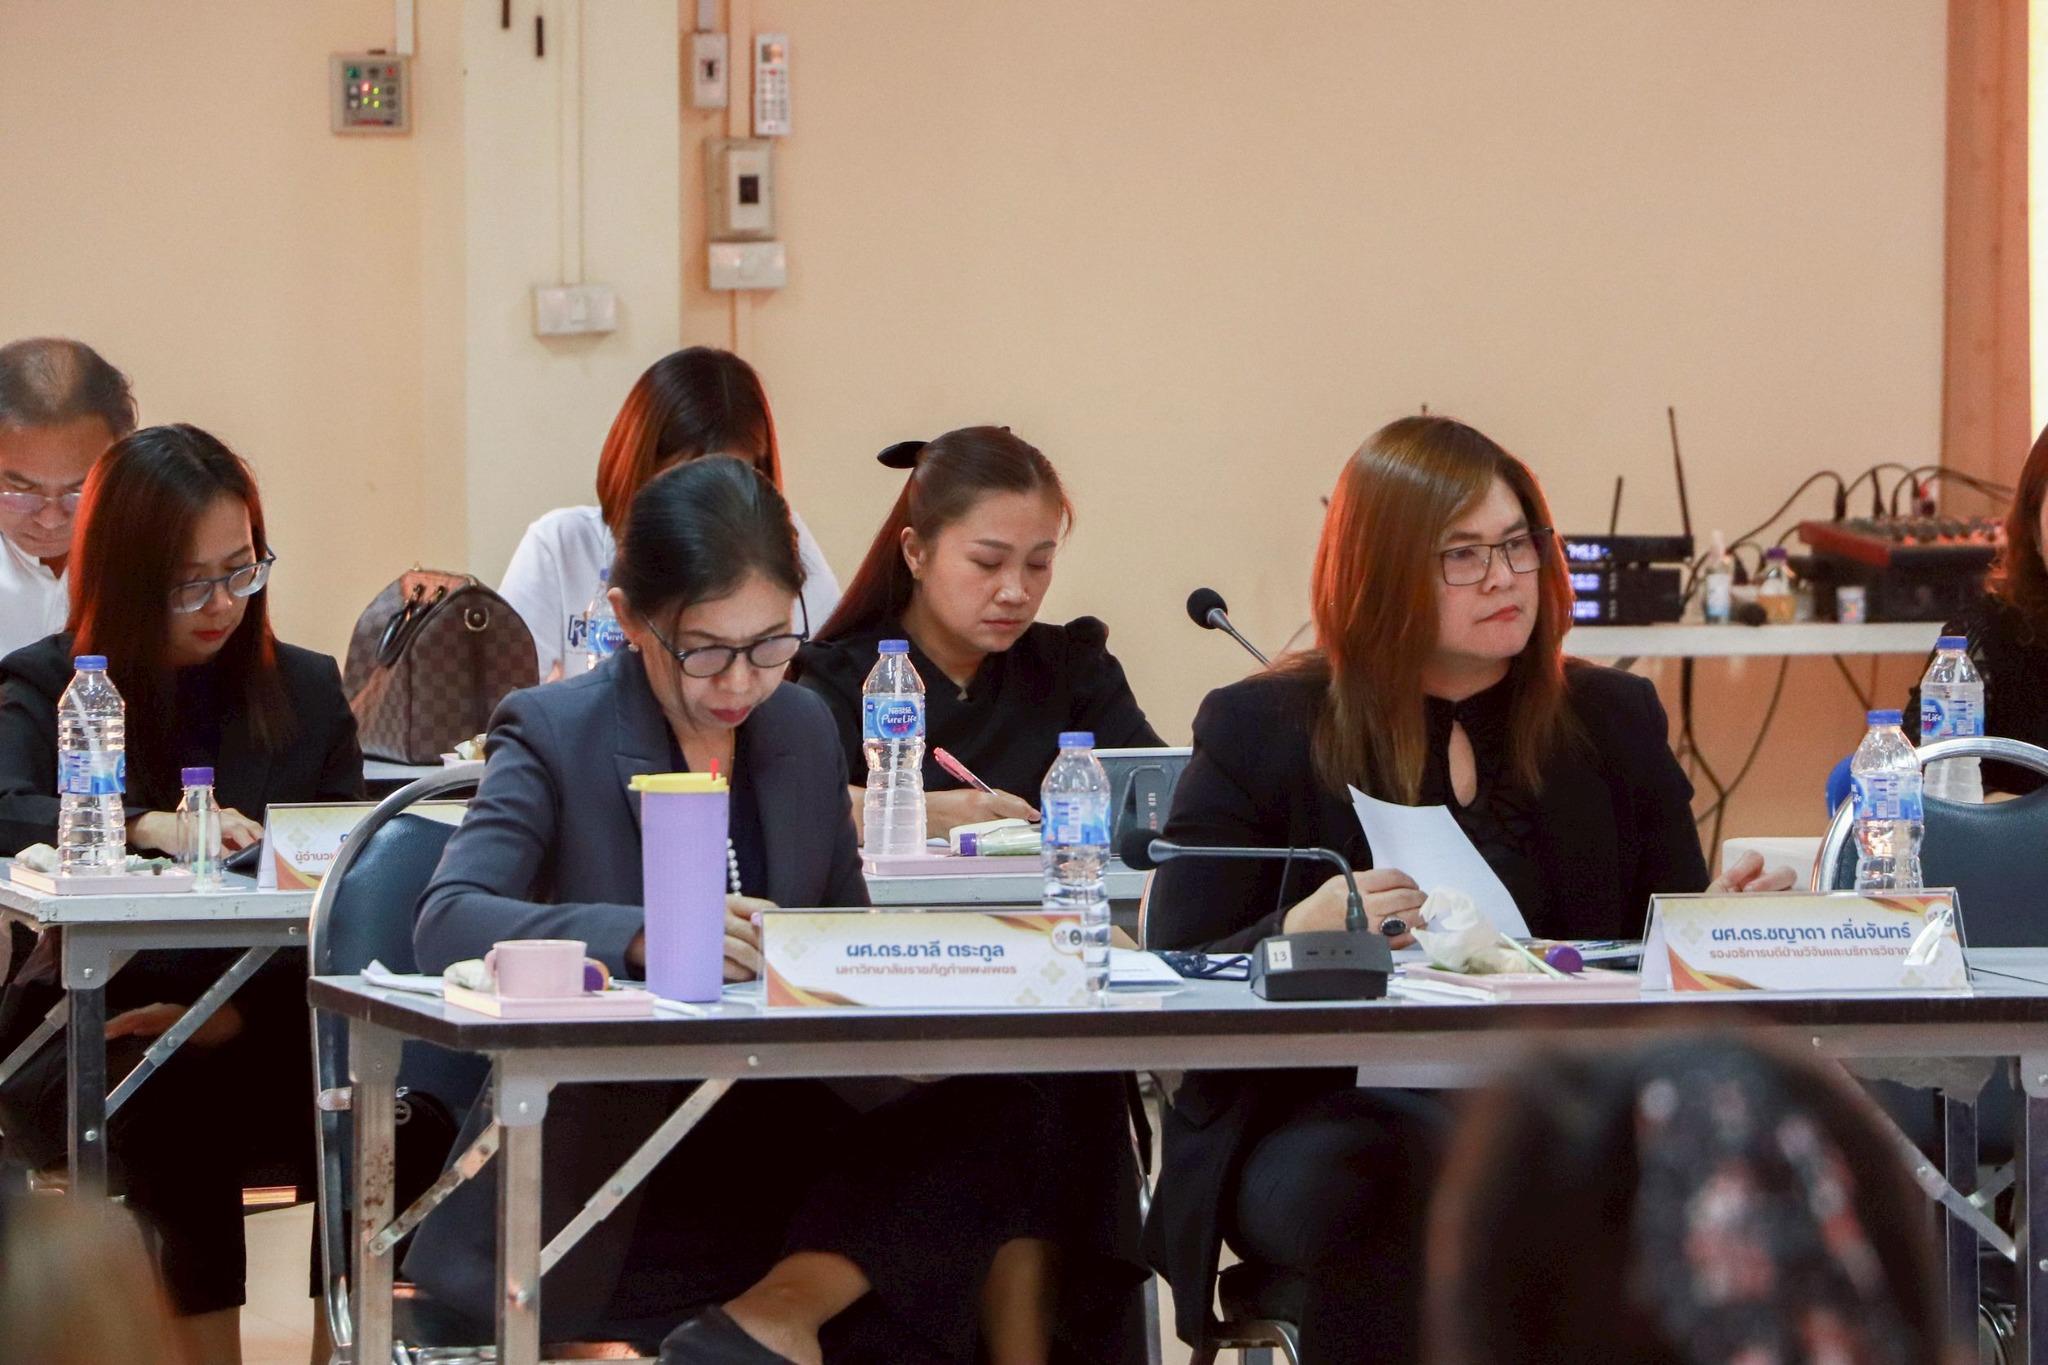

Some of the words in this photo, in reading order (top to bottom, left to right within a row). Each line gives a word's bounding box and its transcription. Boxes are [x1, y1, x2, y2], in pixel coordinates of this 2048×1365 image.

[1711, 926, 1826, 944] ผศ.ดร.ชญาดา
[1831, 918, 1911, 940] กลิ่นจันทร์
[846, 940, 941, 958] ผศ.ดร.ชาลี
[947, 943, 1005, 962] ตระกูล
[1273, 950, 1288, 963] 13
